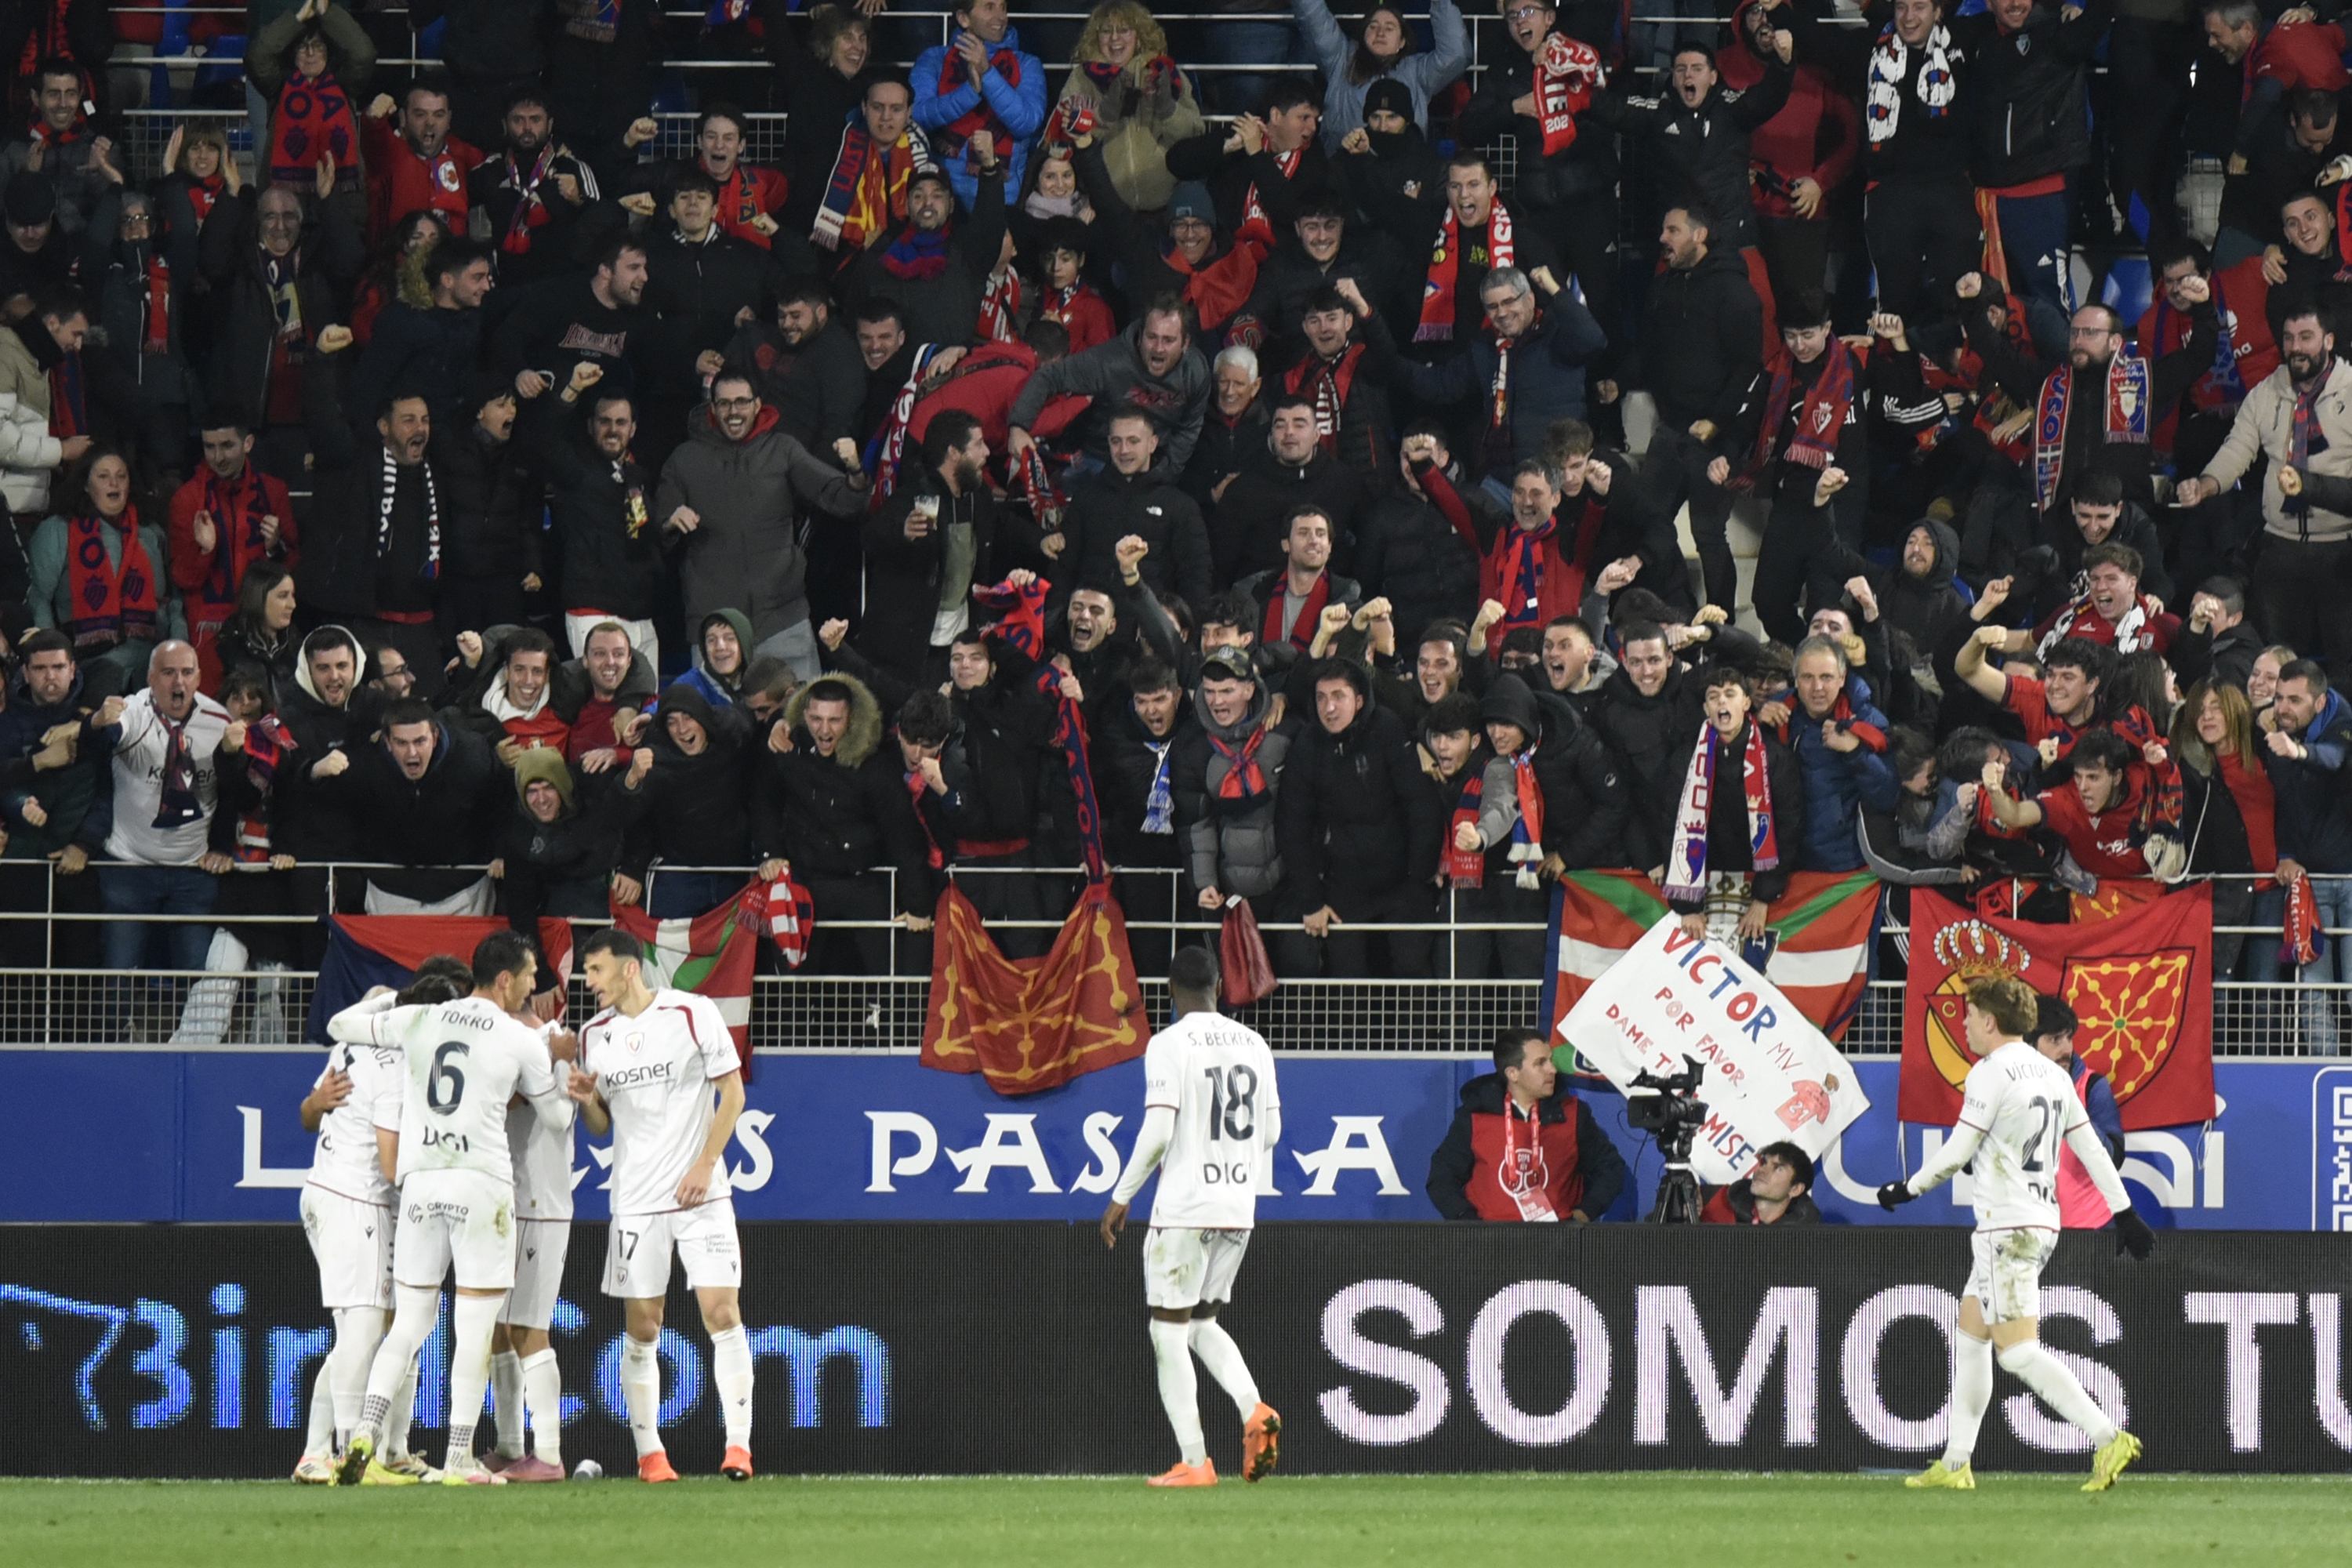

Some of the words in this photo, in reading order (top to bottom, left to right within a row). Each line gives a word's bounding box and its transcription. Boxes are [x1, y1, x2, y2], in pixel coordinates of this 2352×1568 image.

[1654, 986, 1695, 1033] POR
[1662, 927, 1777, 1044] VICTOR
[1188, 1032, 1203, 1047] S.
[1204, 1032, 1256, 1047] BECKER
[1605, 1003, 1655, 1054] DAME
[426, 1040, 470, 1116] 6
[1204, 1064, 1258, 1142] 18
[1788, 1102, 1809, 1126] 21
[2021, 1095, 2063, 1173] 21
[427, 1202, 470, 1215] CRYPTO
[618, 1229, 640, 1261] 17
[1319, 1279, 2127, 1453] SOMOS
